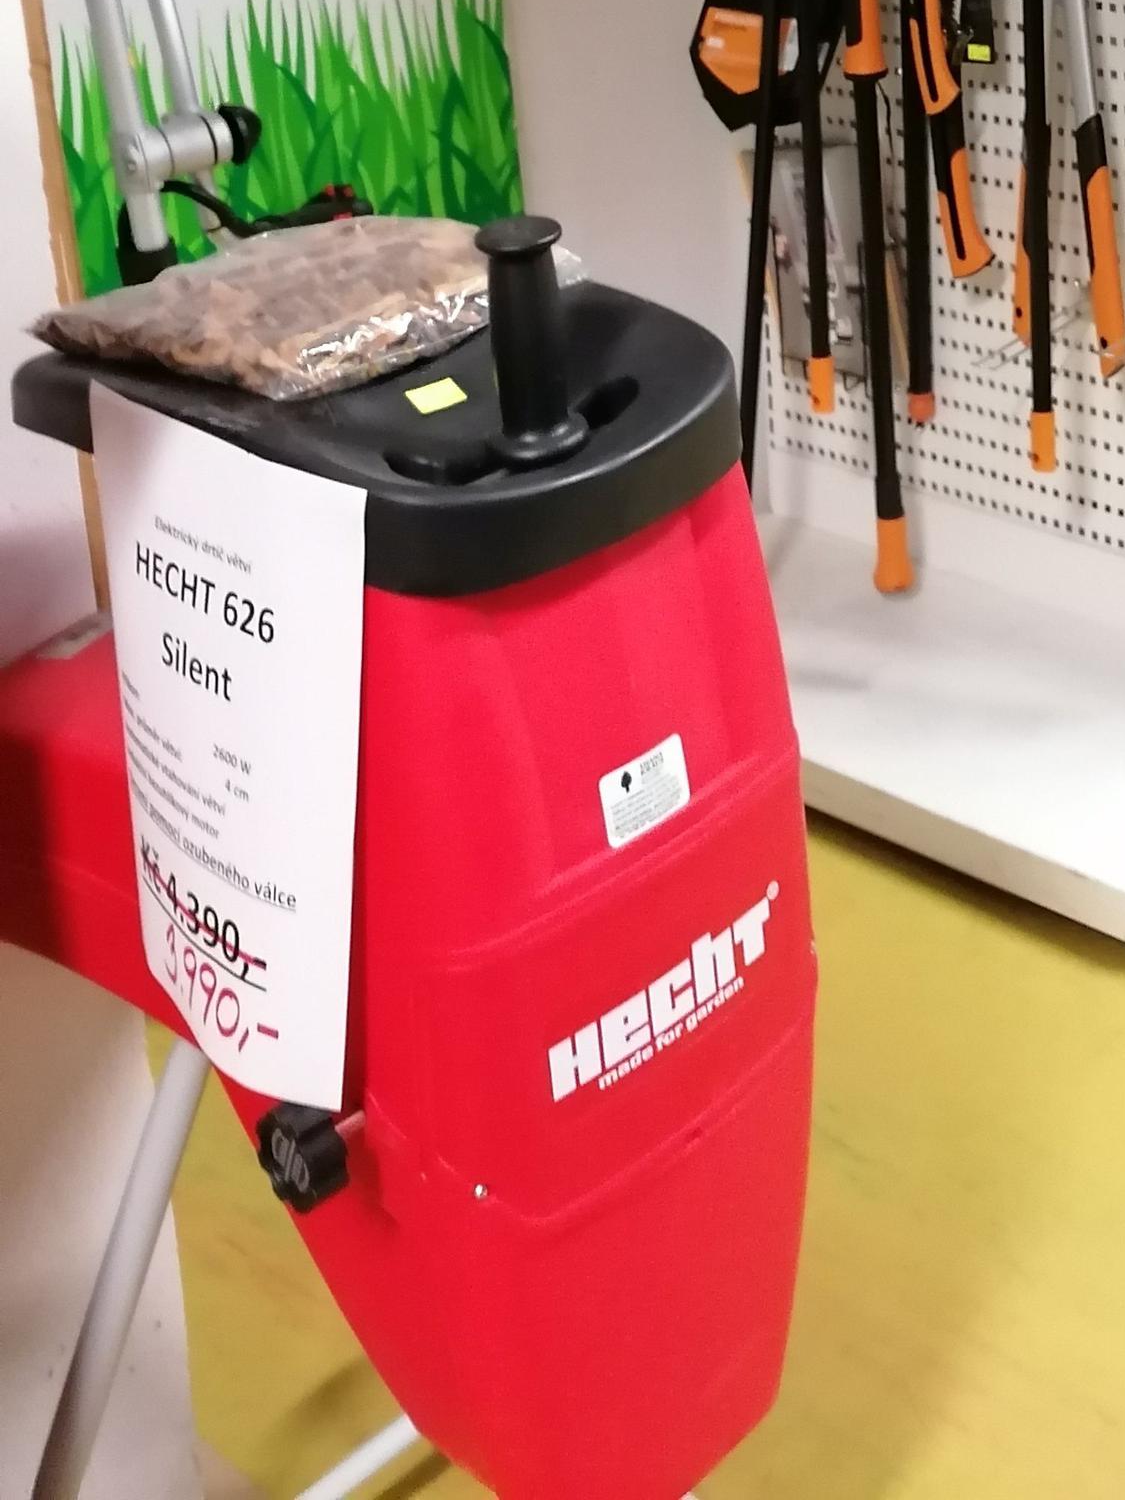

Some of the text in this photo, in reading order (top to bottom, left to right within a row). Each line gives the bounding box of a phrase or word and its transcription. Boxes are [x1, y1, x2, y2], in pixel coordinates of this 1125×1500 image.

[136, 541, 274, 643] HECHT 626
[162, 632, 232, 701] Silent
[213, 743, 252, 775] 2600 W
[233, 785, 249, 802] cm
[182, 836, 250, 889] ozubeného
[254, 881, 296, 908] válce
[141, 836, 267, 981] Kč 4.390,-
[598, 976, 744, 1090] made for garden
